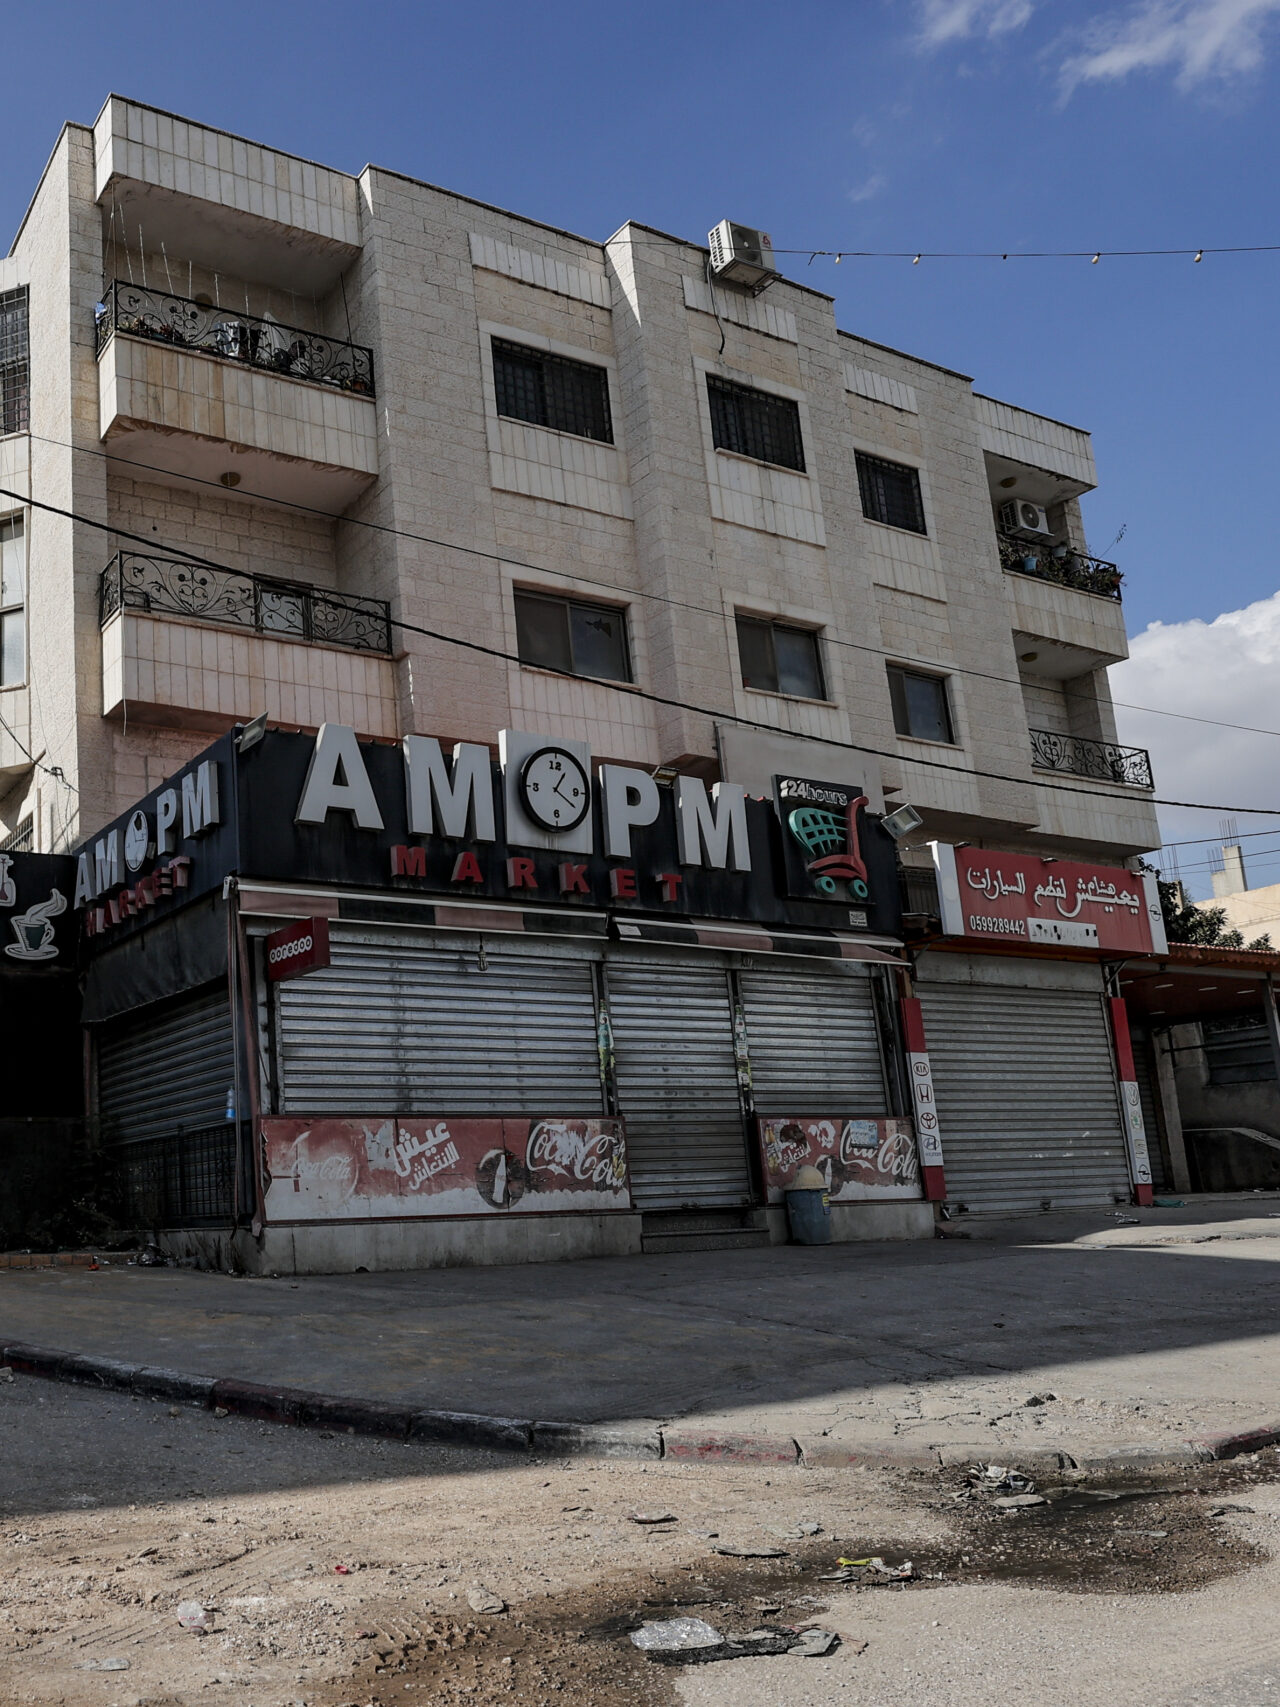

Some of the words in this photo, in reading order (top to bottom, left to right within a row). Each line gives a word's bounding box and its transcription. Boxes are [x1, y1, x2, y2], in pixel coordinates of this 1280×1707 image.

[548, 760, 562, 771] 12
[294, 722, 496, 843] AM
[598, 763, 752, 872] PM
[532, 782, 540, 792] 3
[572, 787, 580, 797] 9
[553, 809, 561, 819] 6
[73, 828, 126, 911] AM
[157, 759, 220, 856] PM
[390, 844, 683, 902] MARKET
[967, 867, 1026, 900] السيارات
[1087, 876, 1116, 896] هشام
[86, 856, 192, 938] MARKET
[1034, 876, 1066, 907] لقطع
[970, 915, 1026, 935] 0599289442
[269, 935, 313, 964] ooredoo
[389, 1122, 451, 1177] عيش
[408, 1141, 460, 1190] الإنتعاش
